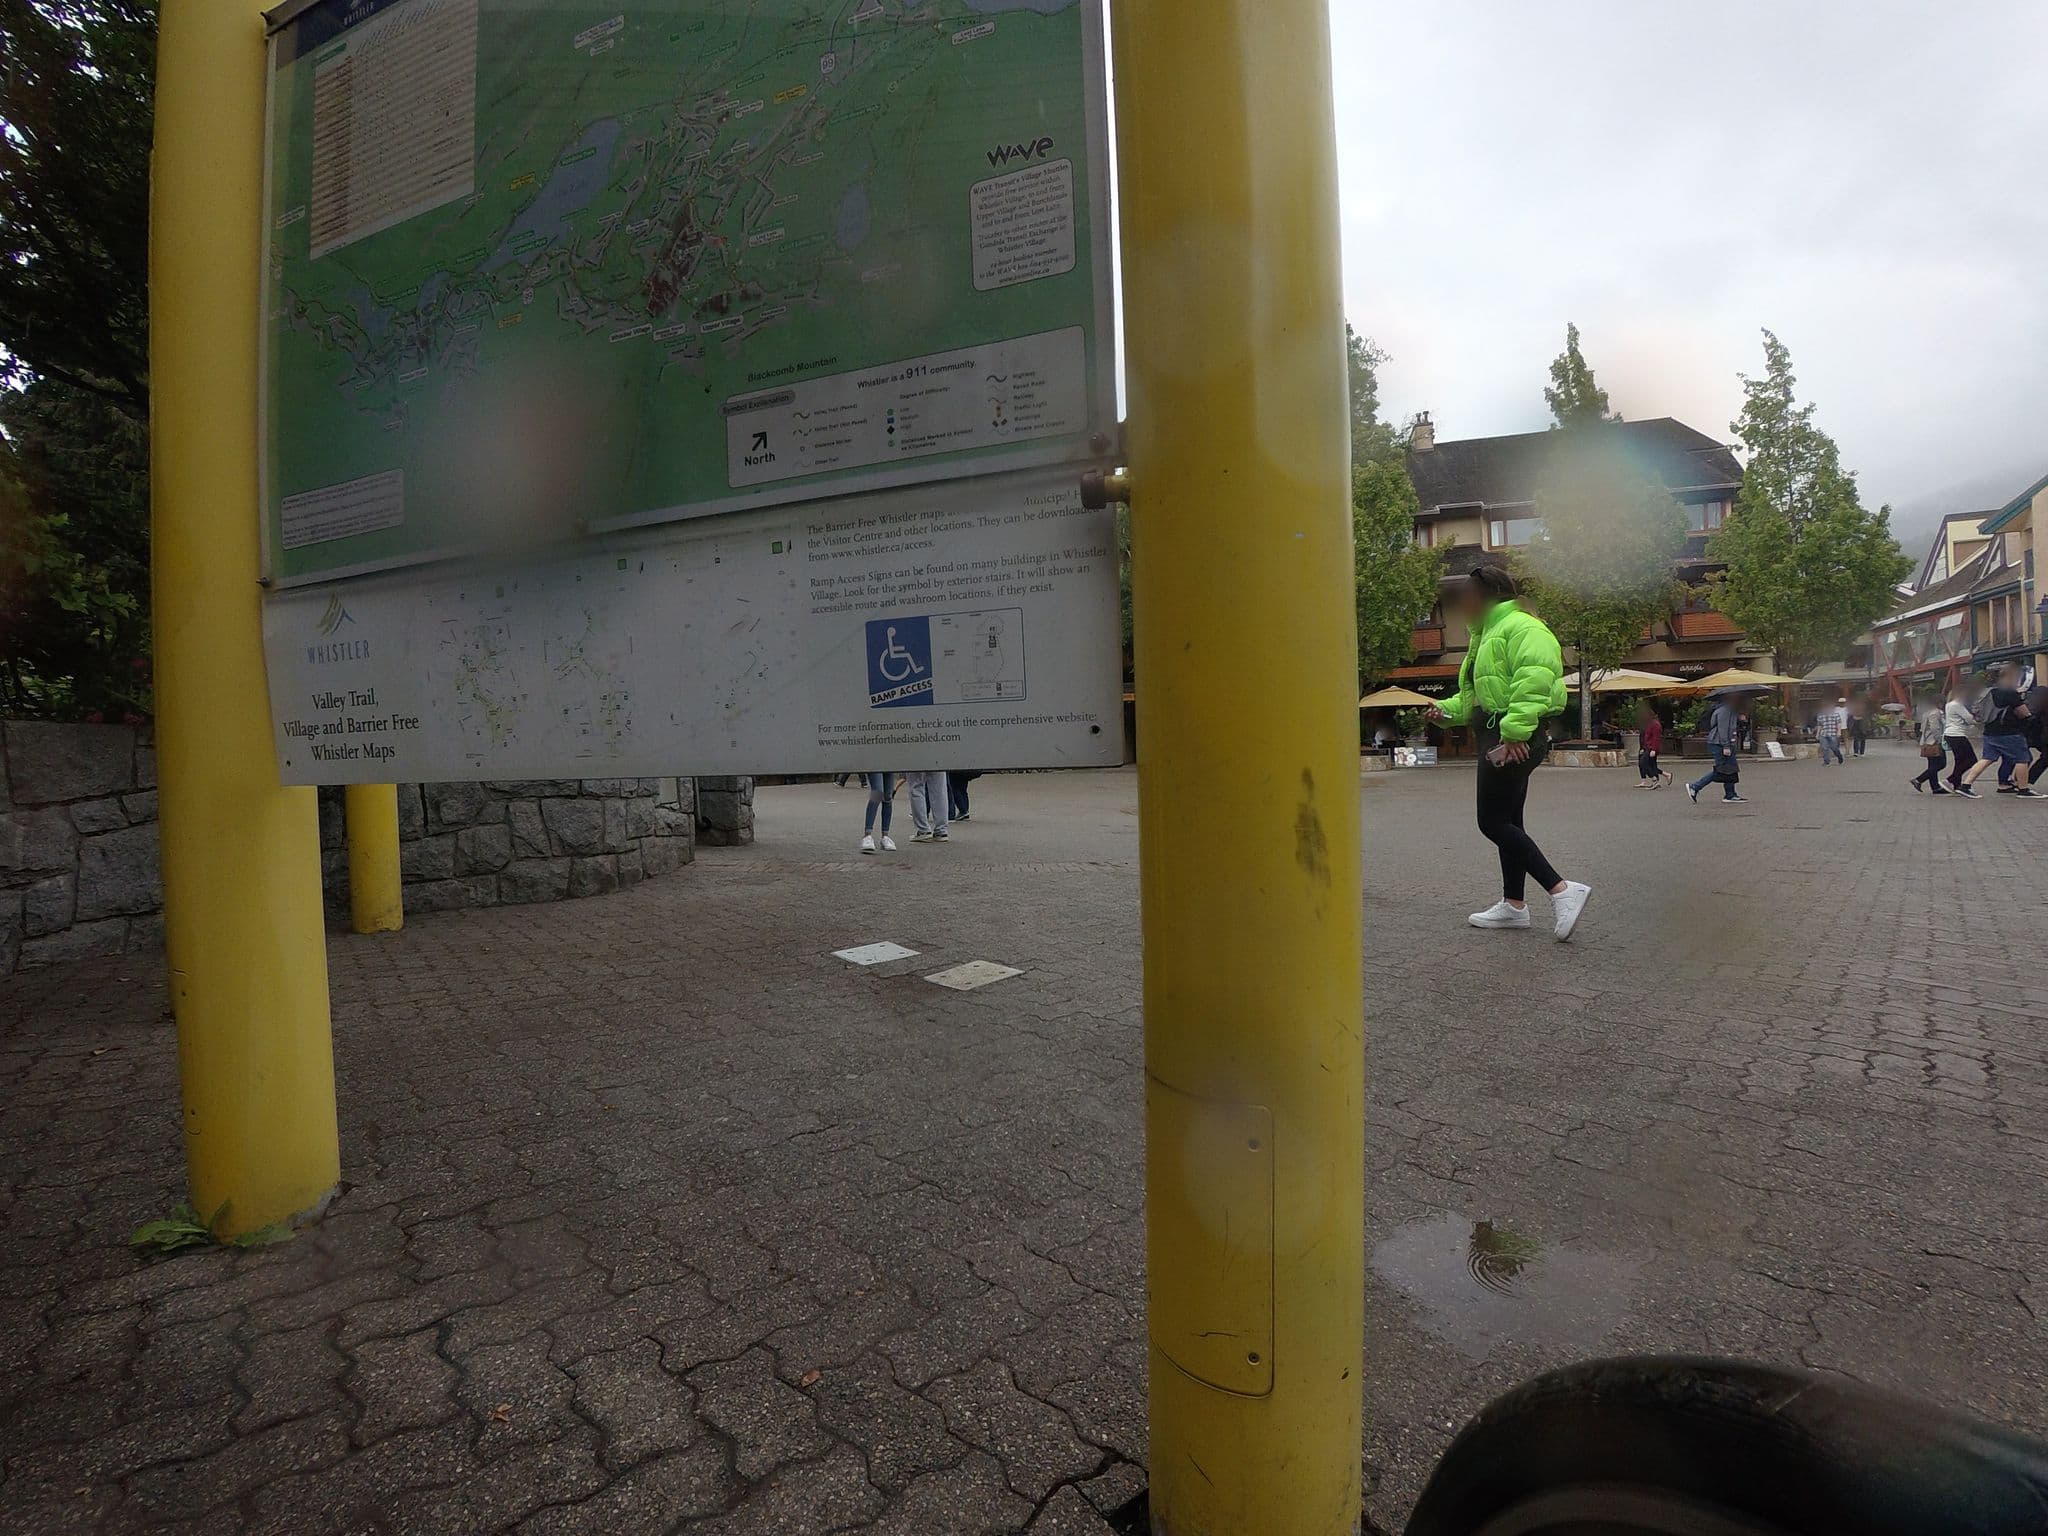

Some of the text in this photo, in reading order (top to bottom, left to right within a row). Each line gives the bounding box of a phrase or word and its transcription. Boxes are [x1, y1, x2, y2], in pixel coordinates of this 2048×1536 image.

[1021, 171, 1042, 183] Village
[747, 356, 837, 382] Blackcomb Mountain
[857, 376, 889, 389] Whistler
[906, 365, 927, 379] 911
[744, 452, 776, 467] North
[807, 524, 824, 535] The
[825, 520, 855, 533] Barrier
[858, 517, 877, 528] Free
[879, 511, 917, 525] Whistler
[807, 538, 820, 549] the
[823, 534, 850, 546] Visitor
[853, 531, 882, 543] Centre
[885, 527, 901, 538] and
[904, 524, 928, 536] other
[930, 517, 976, 532] locations.
[976, 514, 1000, 527] They
[1003, 513, 1021, 524] can
[1023, 509, 1036, 520] be
[808, 551, 830, 563] from
[810, 576, 834, 588] Ramp
[837, 572, 865, 584] Access
[868, 569, 892, 582] Signs
[894, 568, 911, 578] can
[913, 565, 925, 576] be
[926, 561, 954, 574] found
[956, 562, 968, 571] on
[971, 558, 998, 569] many
[1001, 551, 1046, 566] buildings
[1049, 549, 1060, 561] in
[810, 564, 1091, 602] Village. Look for the symbol by exterior stairs. It will show an
[811, 601, 854, 614] accessible
[855, 599, 878, 610] route
[880, 595, 897, 607] and
[899, 590, 947, 605] washroom
[997, 585, 1006, 597] if
[1006, 582, 1027, 596] they
[1029, 580, 1055, 593] exist.
[307, 639, 370, 664] WHISTLER
[312, 688, 379, 712] Valley Trail,
[871, 680, 933, 704] RAMP ACCESS
[283, 714, 420, 740] Village and Barrier Free
[818, 724, 832, 733] For
[834, 724, 856, 732] more
[858, 720, 913, 731] information,
[916, 718, 943, 729] check
[945, 716, 960, 728] out
[963, 716, 978, 727] the
[979, 714, 1054, 728] comprehensive
[818, 731, 961, 746] www.whistlerforthedisabled.com
[311, 742, 395, 763] Whistler Maps
